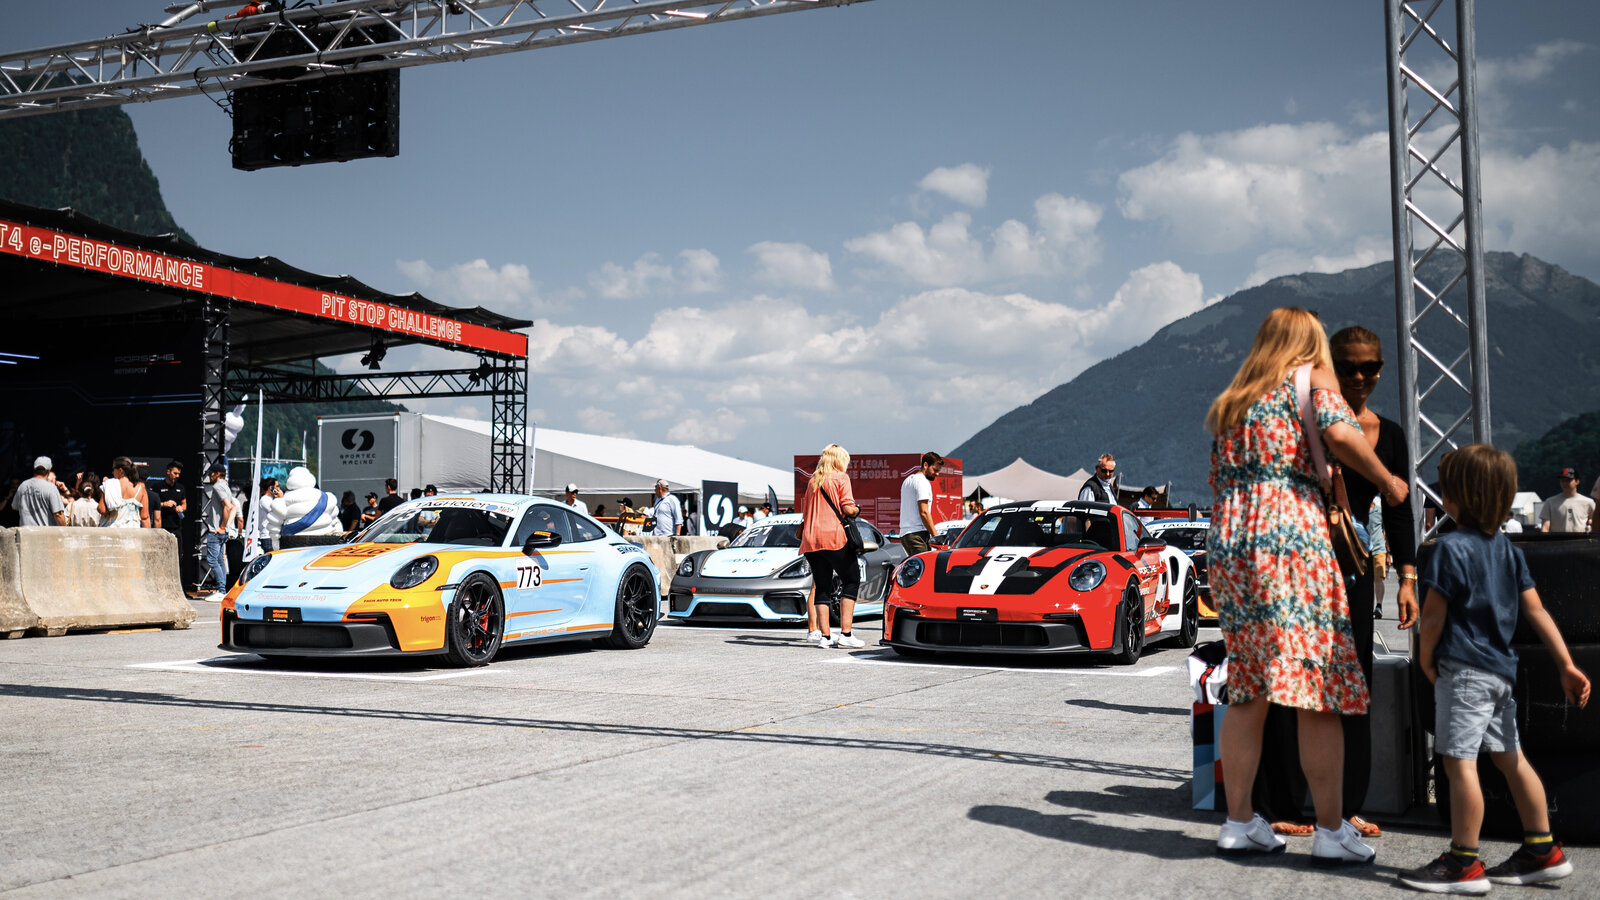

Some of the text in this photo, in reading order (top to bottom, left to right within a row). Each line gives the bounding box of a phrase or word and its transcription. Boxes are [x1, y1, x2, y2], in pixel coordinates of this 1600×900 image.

[29, 234, 204, 289] e-PERFORMANCE
[321, 293, 462, 342] PIT STOP CHALLENGE
[860, 459, 890, 469] LEGAL
[860, 469, 899, 480] MODELS
[985, 506, 1109, 517] PORSCHE
[993, 553, 1017, 563] 5
[517, 565, 541, 589] 773
[521, 627, 568, 639] PORSCHE
